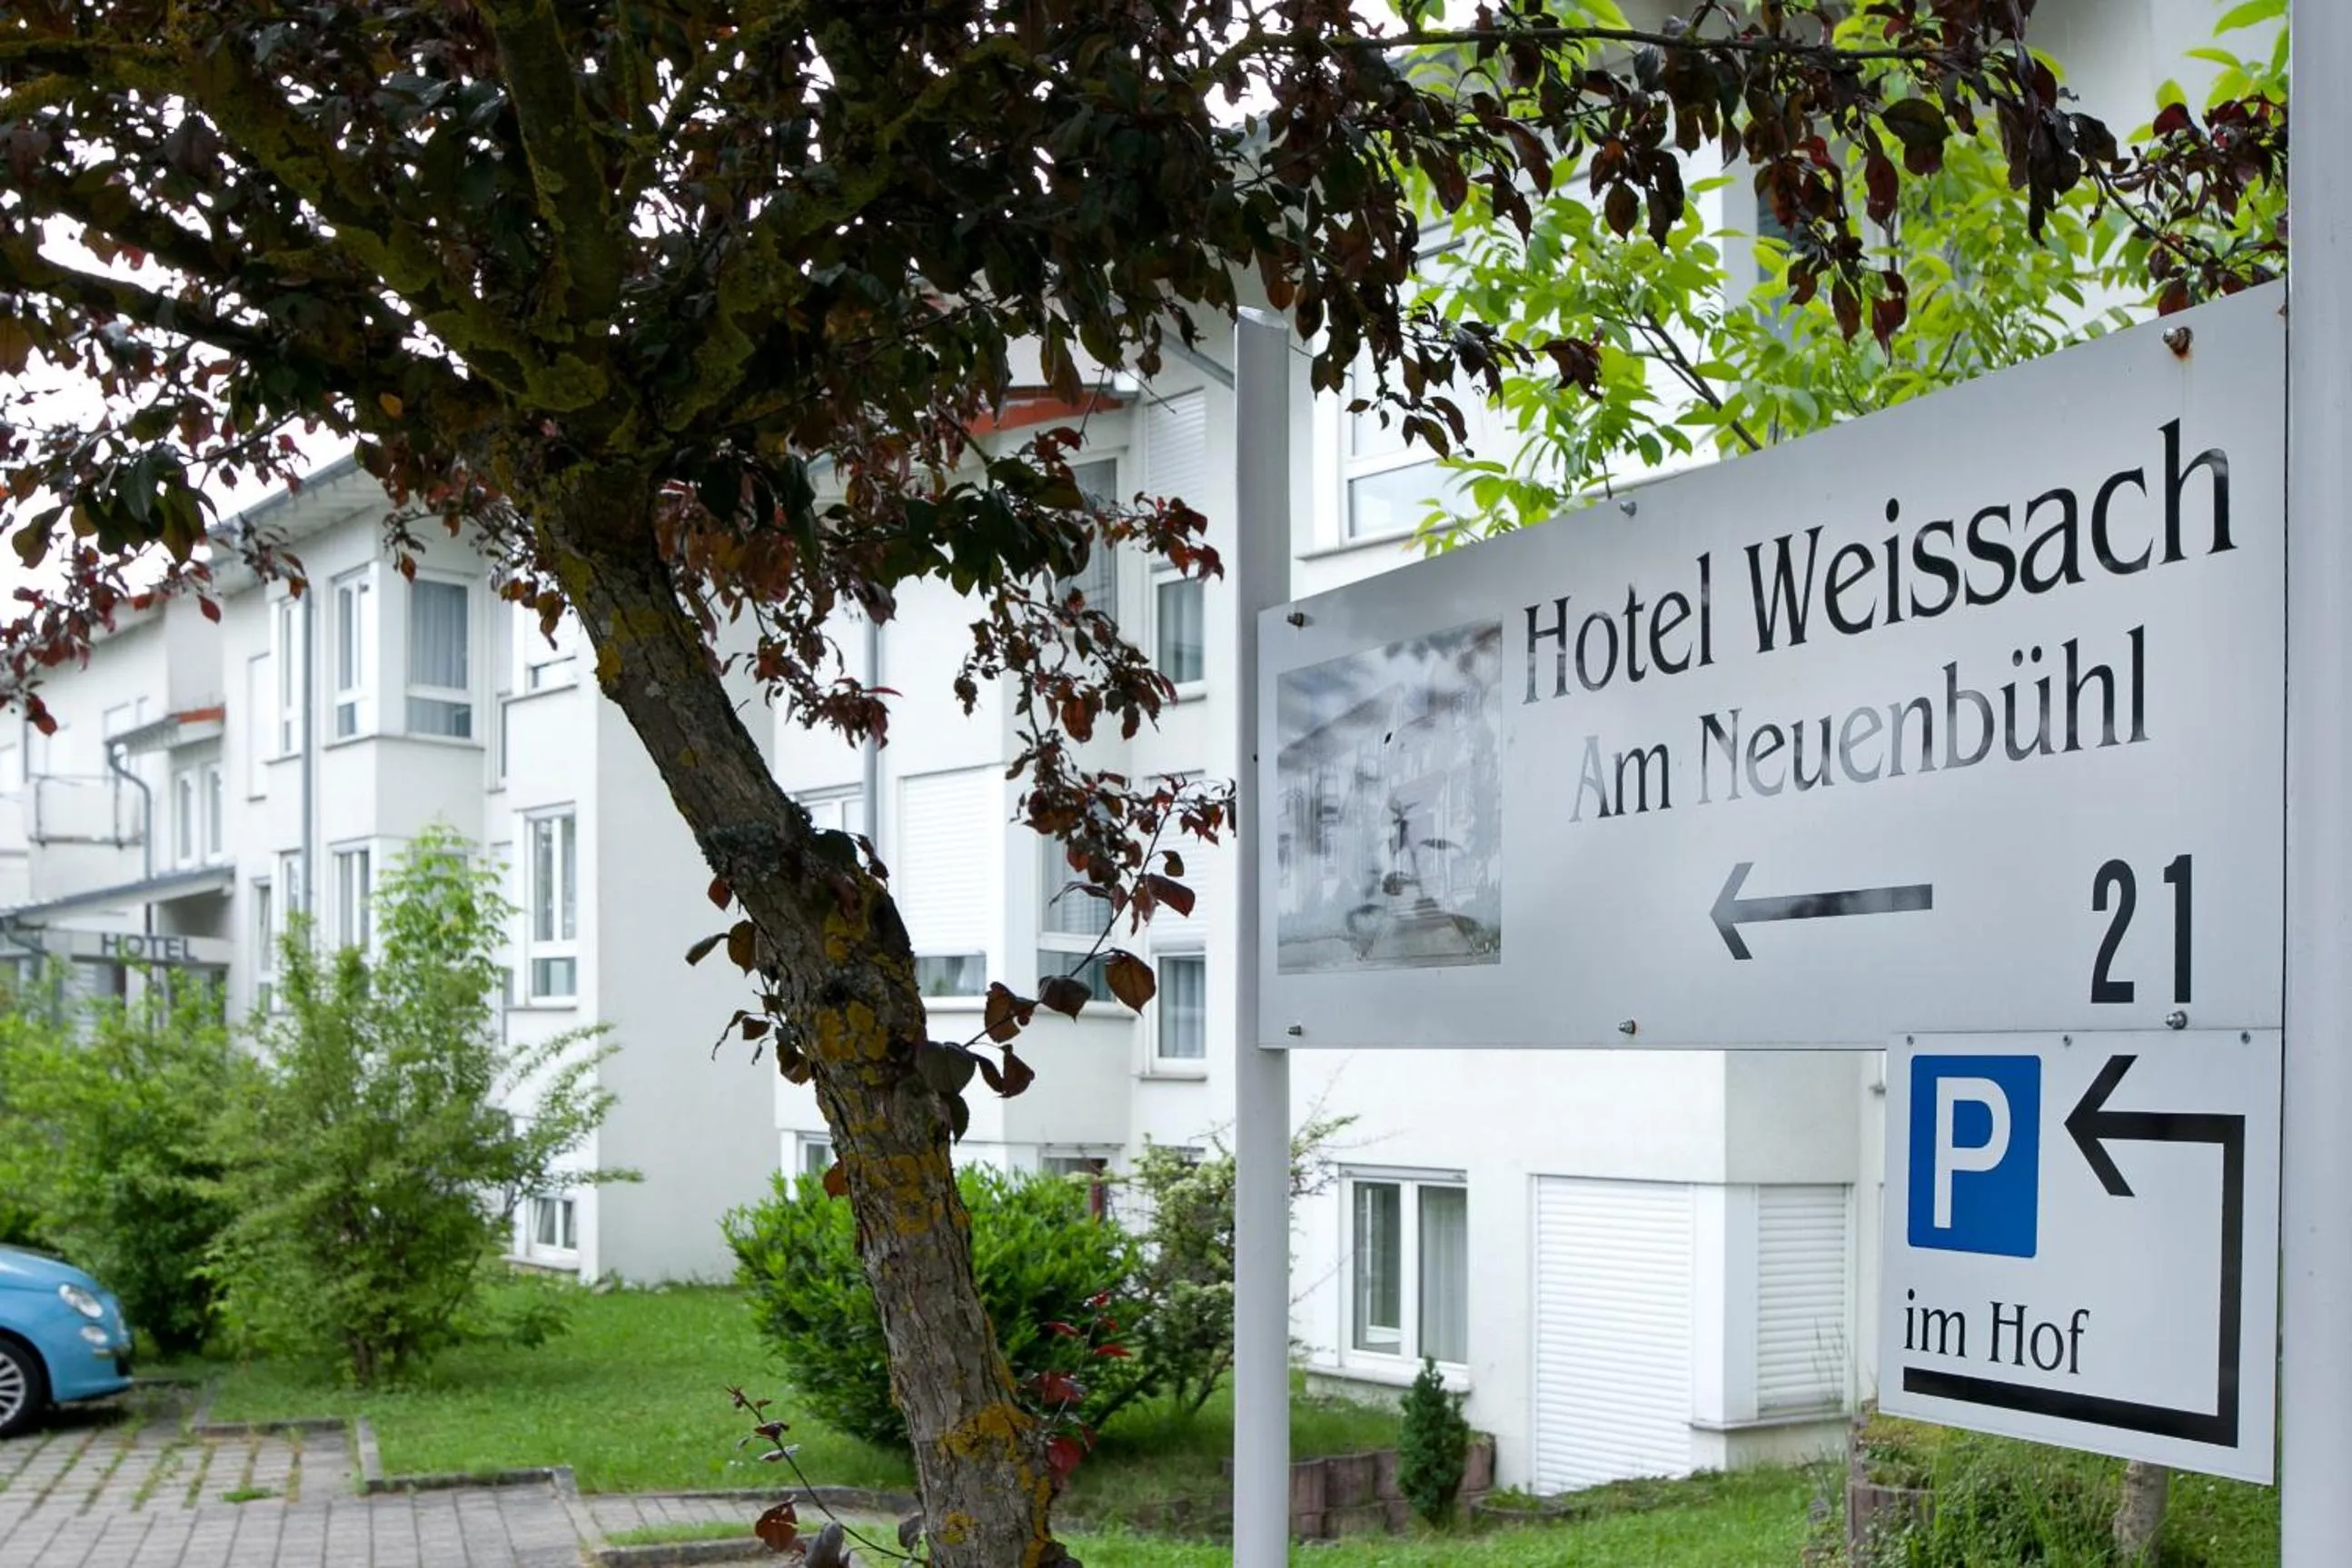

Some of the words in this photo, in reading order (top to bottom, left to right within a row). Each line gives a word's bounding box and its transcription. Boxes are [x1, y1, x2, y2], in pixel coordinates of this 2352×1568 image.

[1522, 551, 1714, 704] Hotel
[1743, 418, 2238, 653] Weissach
[1569, 734, 1672, 822] Am
[1697, 624, 2150, 805] Neuenbühl
[101, 932, 199, 962] HOTEL
[2091, 854, 2192, 1003] 21
[1932, 1077, 2011, 1228] P
[1904, 1288, 1967, 1358] im
[1989, 1301, 2090, 1374] Hof
